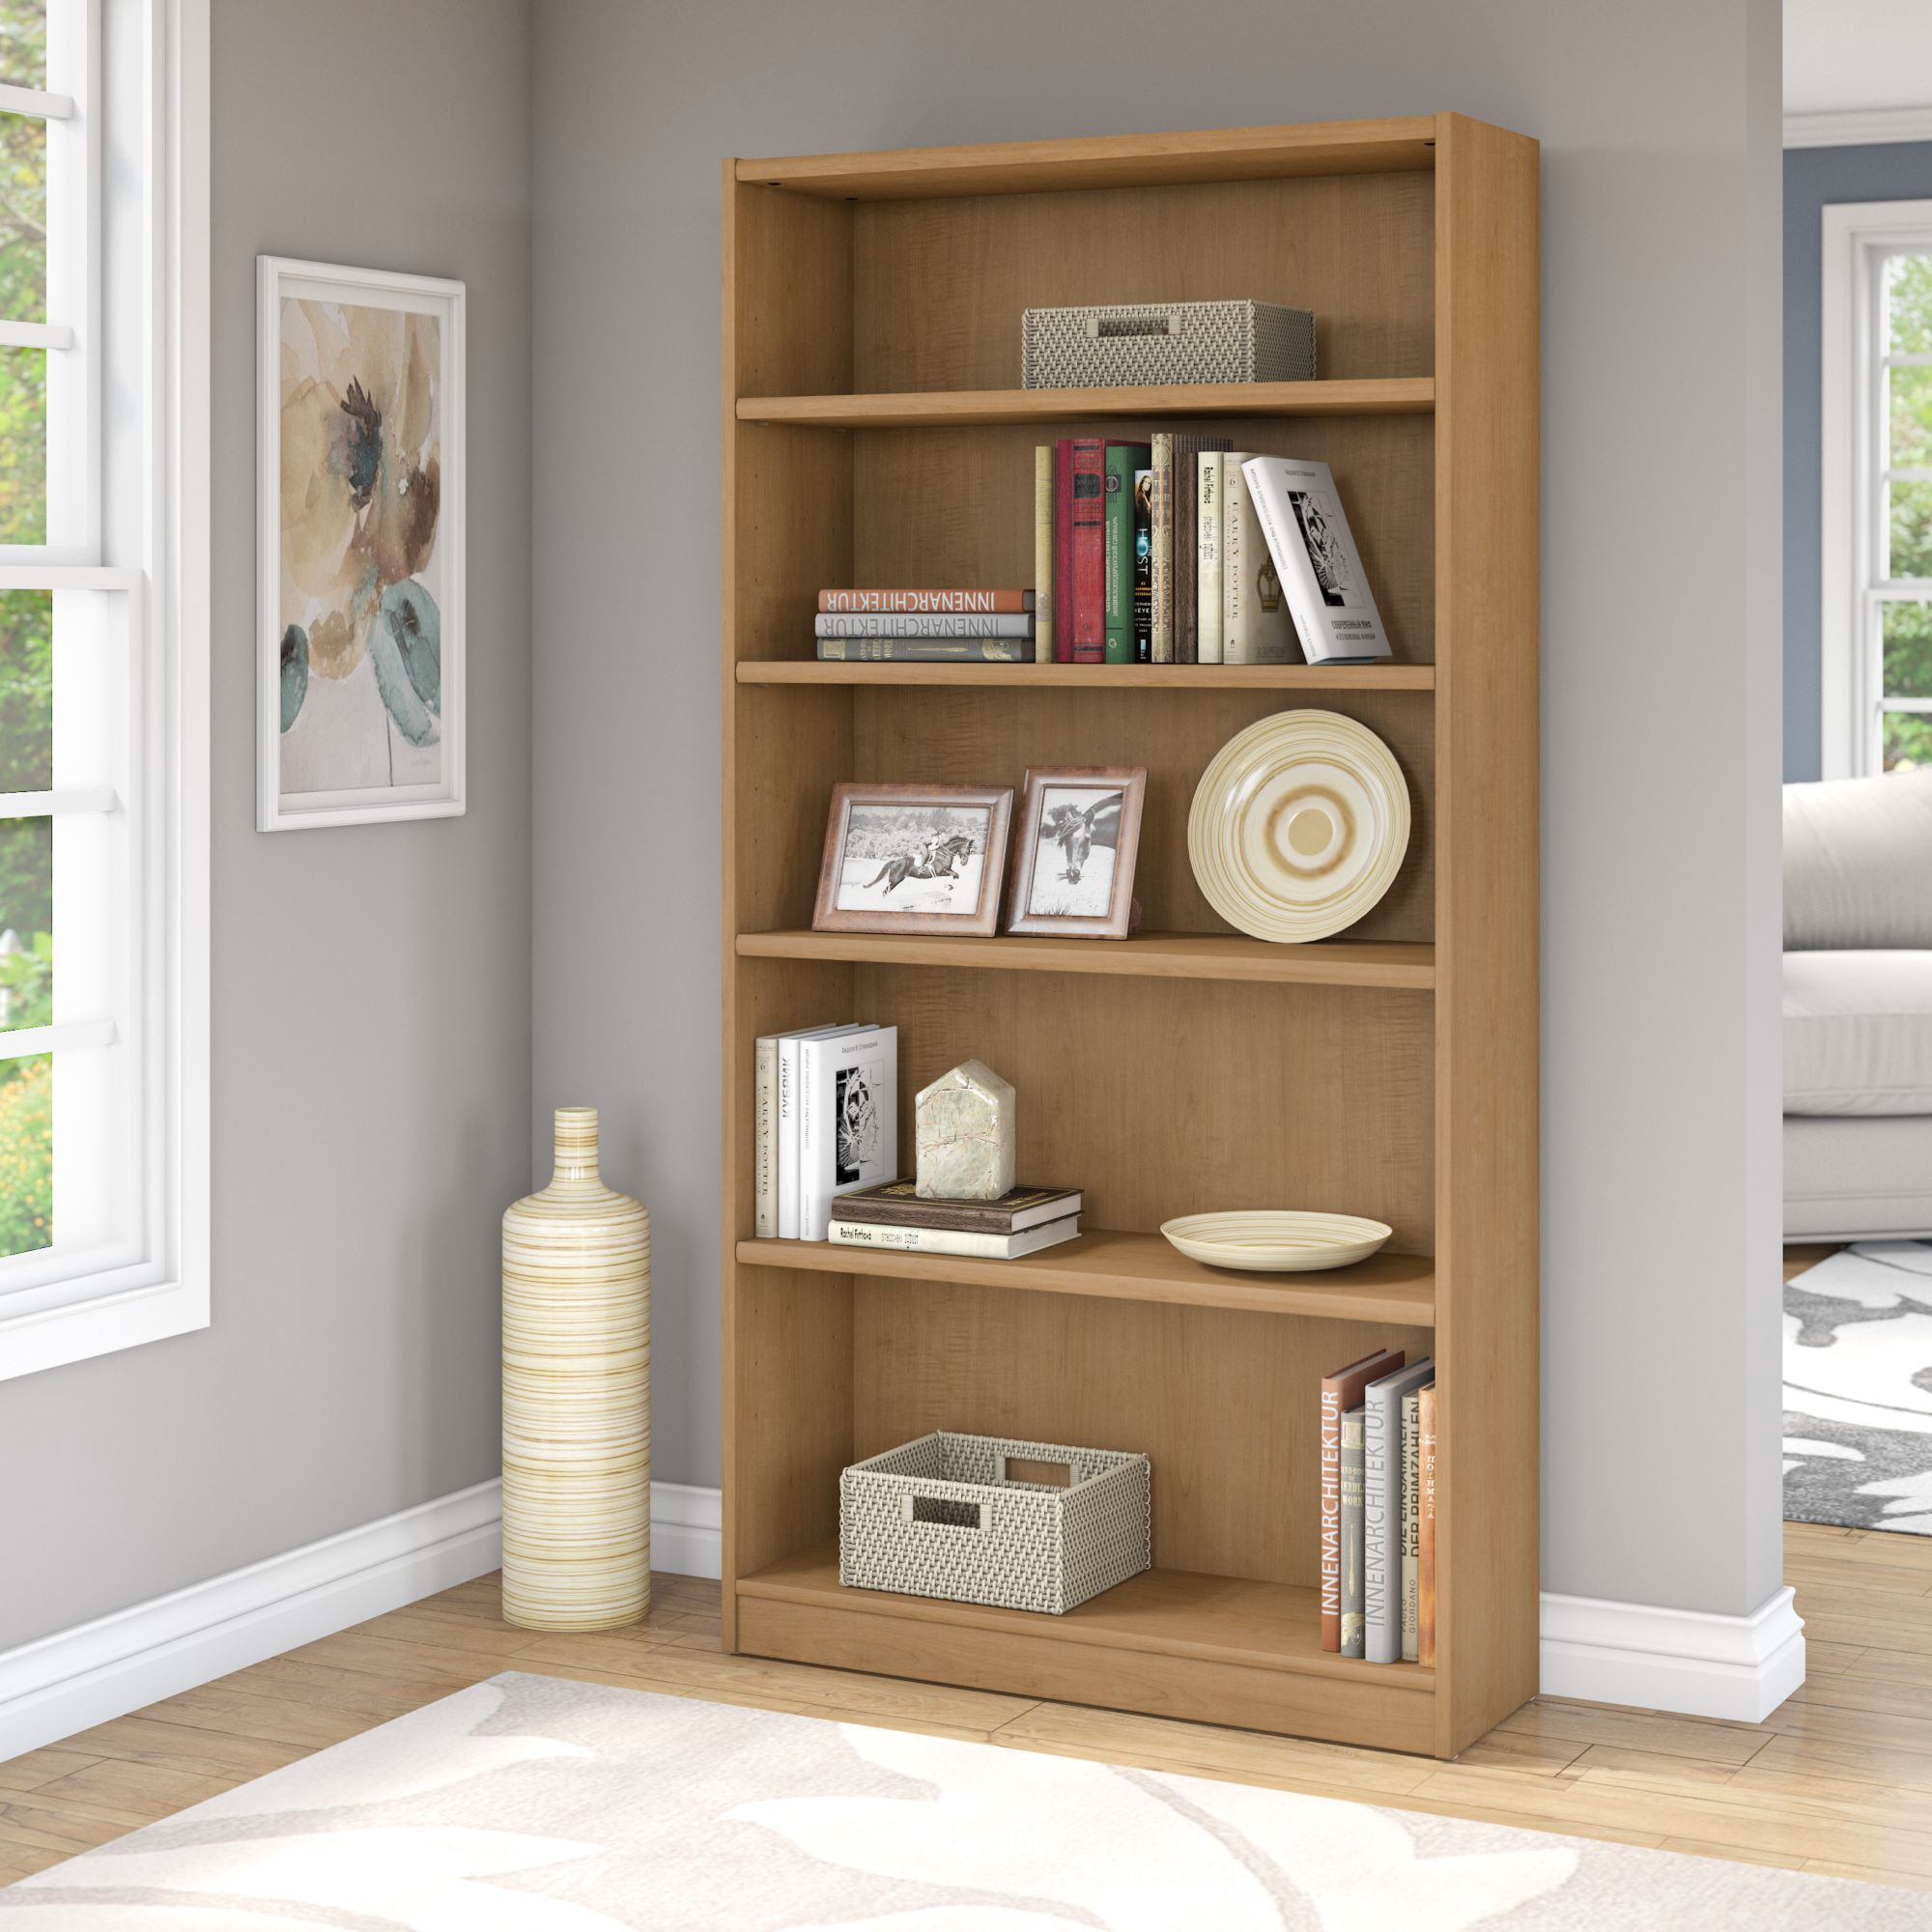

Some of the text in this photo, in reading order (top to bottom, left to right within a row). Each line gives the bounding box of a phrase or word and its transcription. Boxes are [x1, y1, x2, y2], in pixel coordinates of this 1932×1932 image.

[1204, 467, 1214, 482] Rachel
[1137, 528, 1149, 575] HOST
[827, 591, 995, 611] INNENARCHITEKTUR
[824, 618, 999, 638] INNENARCHITEKTUR
[1321, 1391, 1339, 1615] INNENARCHITEKTUR
[1365, 1399, 1385, 1627] INNENARCHITEKTUR
